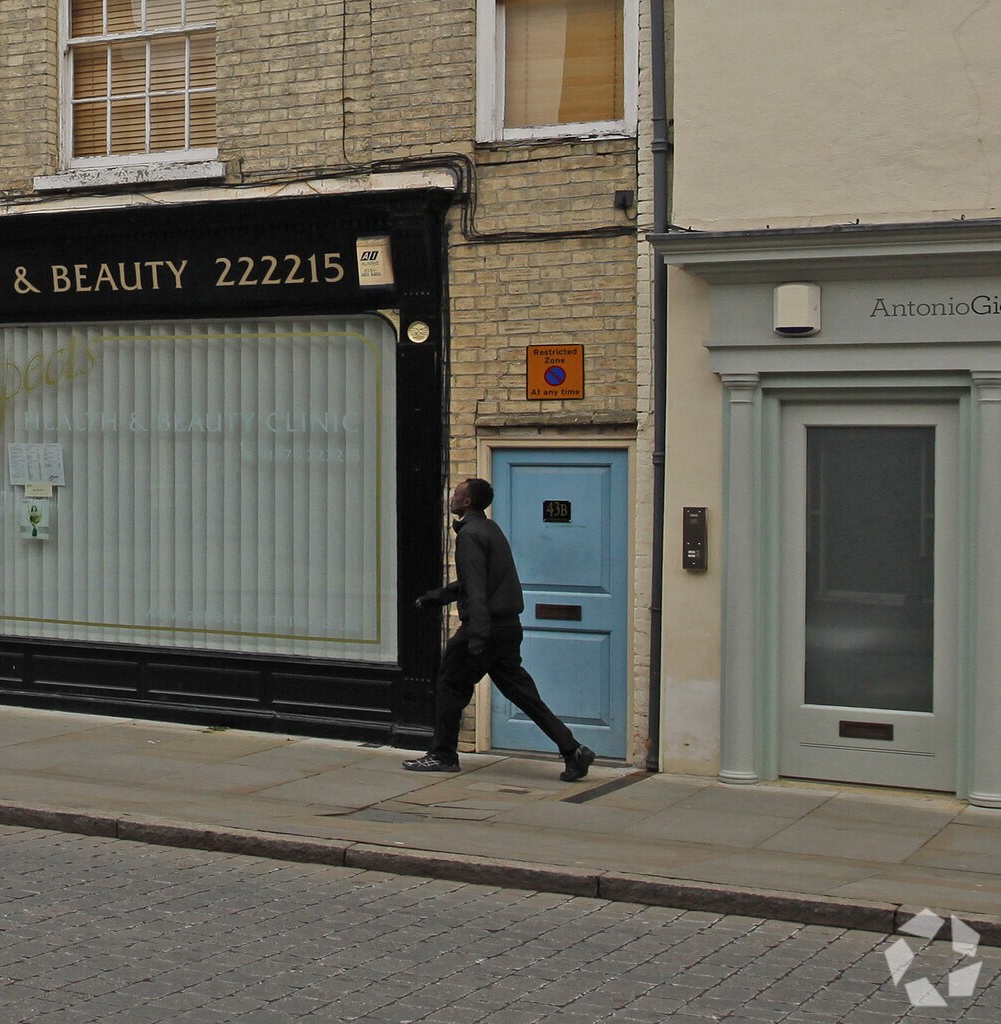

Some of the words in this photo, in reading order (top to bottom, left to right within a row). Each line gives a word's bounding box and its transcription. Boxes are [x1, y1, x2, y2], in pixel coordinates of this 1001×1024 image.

[13, 266, 41, 295] &
[51, 259, 188, 294] BEAUTY
[214, 252, 344, 287] 222215
[531, 388, 541, 396] At
[543, 389, 558, 397] any
[24, 411, 118, 431] HEALTH
[130, 412, 148, 432] &
[157, 411, 256, 432] BEAUTY
[266, 411, 360, 432] CLINIC
[546, 501, 568, 517] 43B
